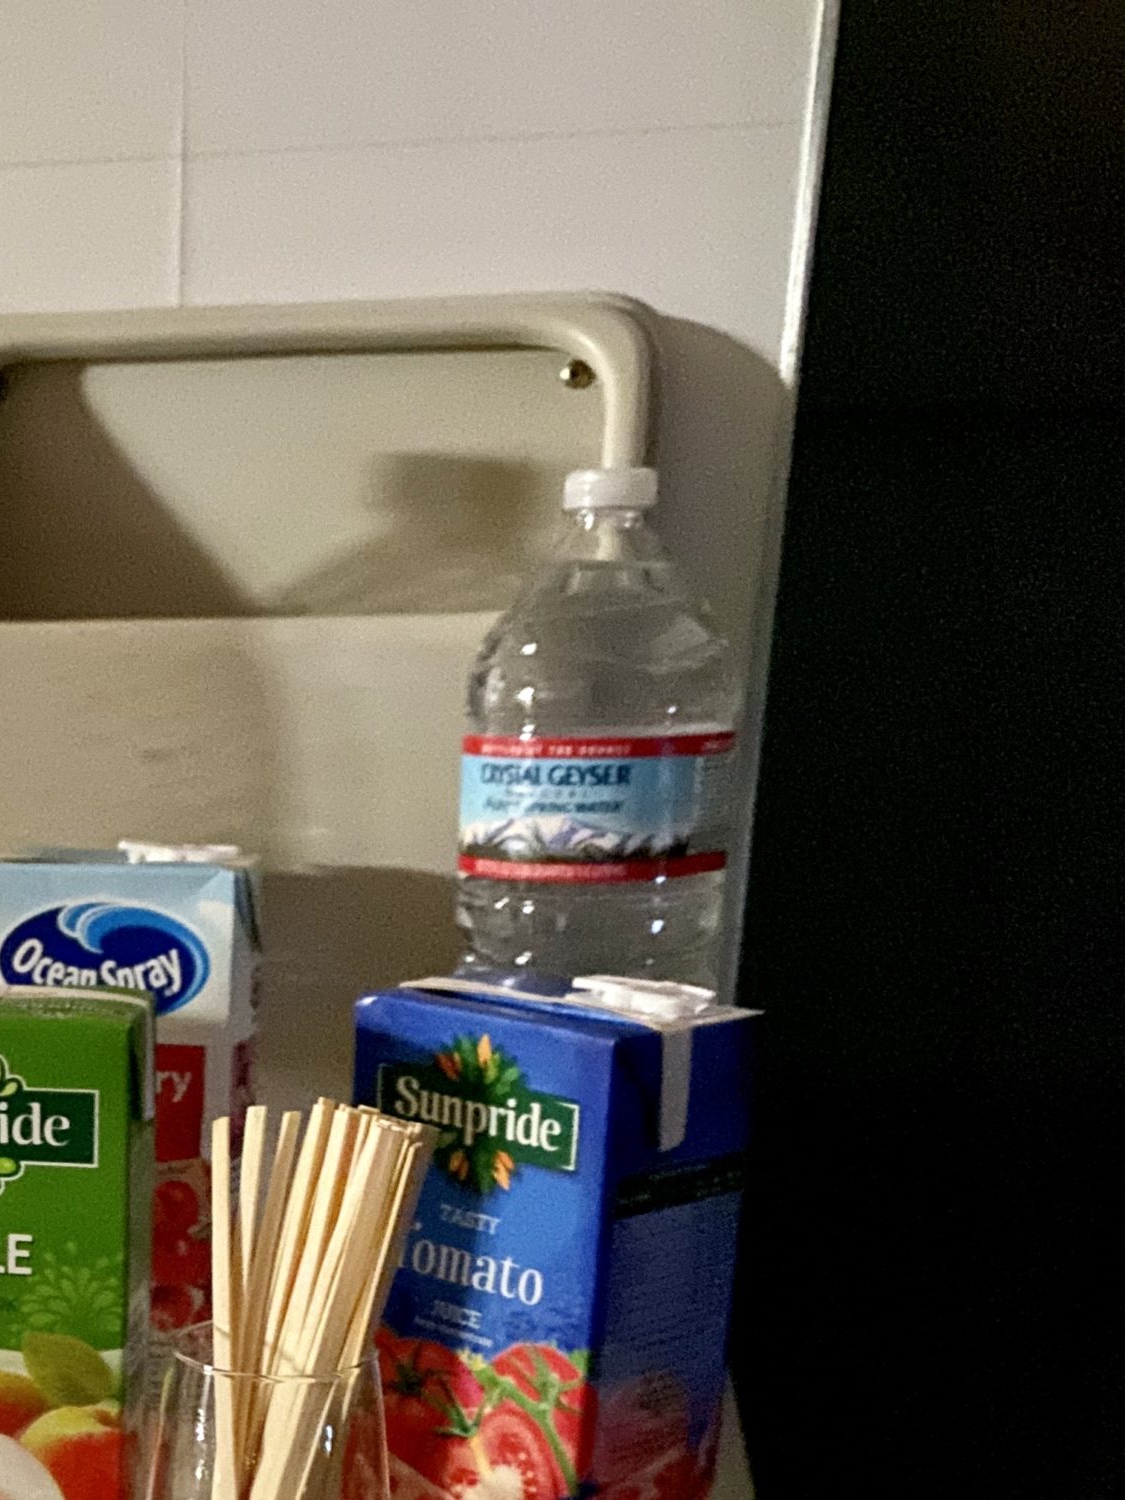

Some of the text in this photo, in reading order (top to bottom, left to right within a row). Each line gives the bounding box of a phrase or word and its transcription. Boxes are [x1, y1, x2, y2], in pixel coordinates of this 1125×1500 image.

[548, 763, 632, 786] GEYSER
[12, 938, 97, 987] Ocean
[396, 1075, 563, 1152] Sunpride
[440, 1203, 502, 1235] TASTY
[407, 1232, 544, 1306] omato
